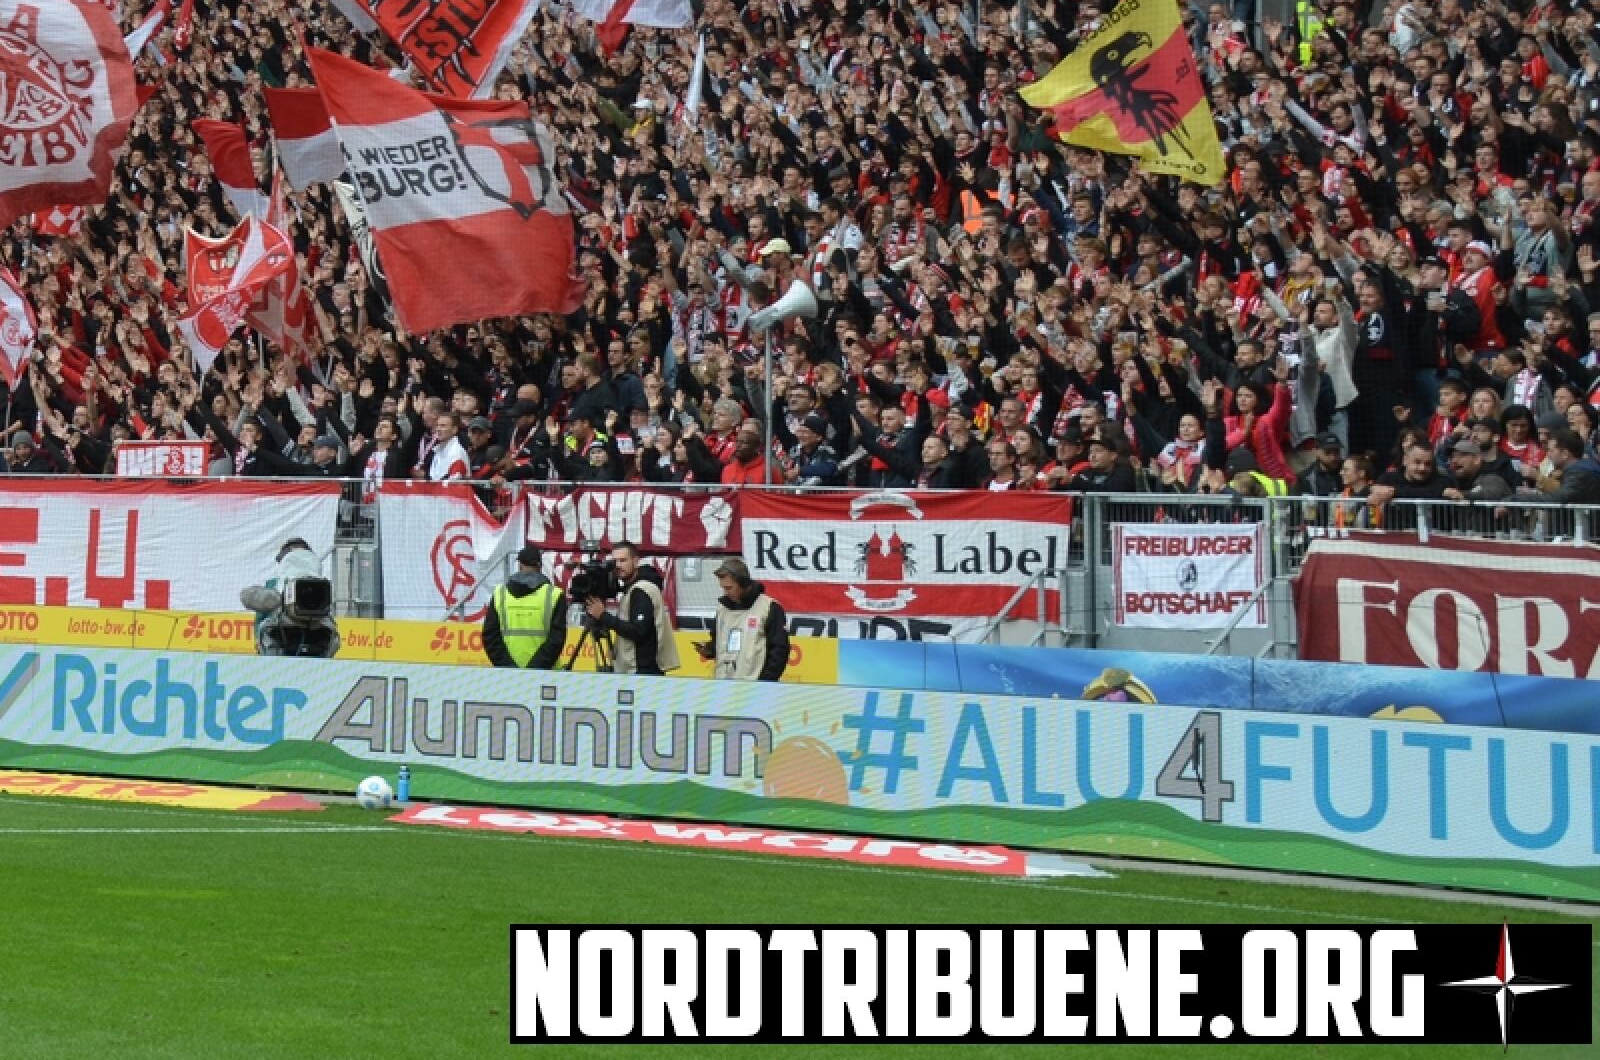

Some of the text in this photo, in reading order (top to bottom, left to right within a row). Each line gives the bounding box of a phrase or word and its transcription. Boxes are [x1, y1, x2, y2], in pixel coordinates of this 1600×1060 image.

[359, 135, 451, 165] WIEDER
[752, 529, 1058, 578] Red Label
[1125, 534, 1253, 558] FREIBURGER
[1125, 590, 1253, 615] BOTSCHAFT
[66, 615, 147, 638] lotto-bw.de
[208, 617, 256, 641] LOTT
[51, 651, 775, 780] Richter Aluminium
[840, 691, 1600, 856] #ALU4FUTU
